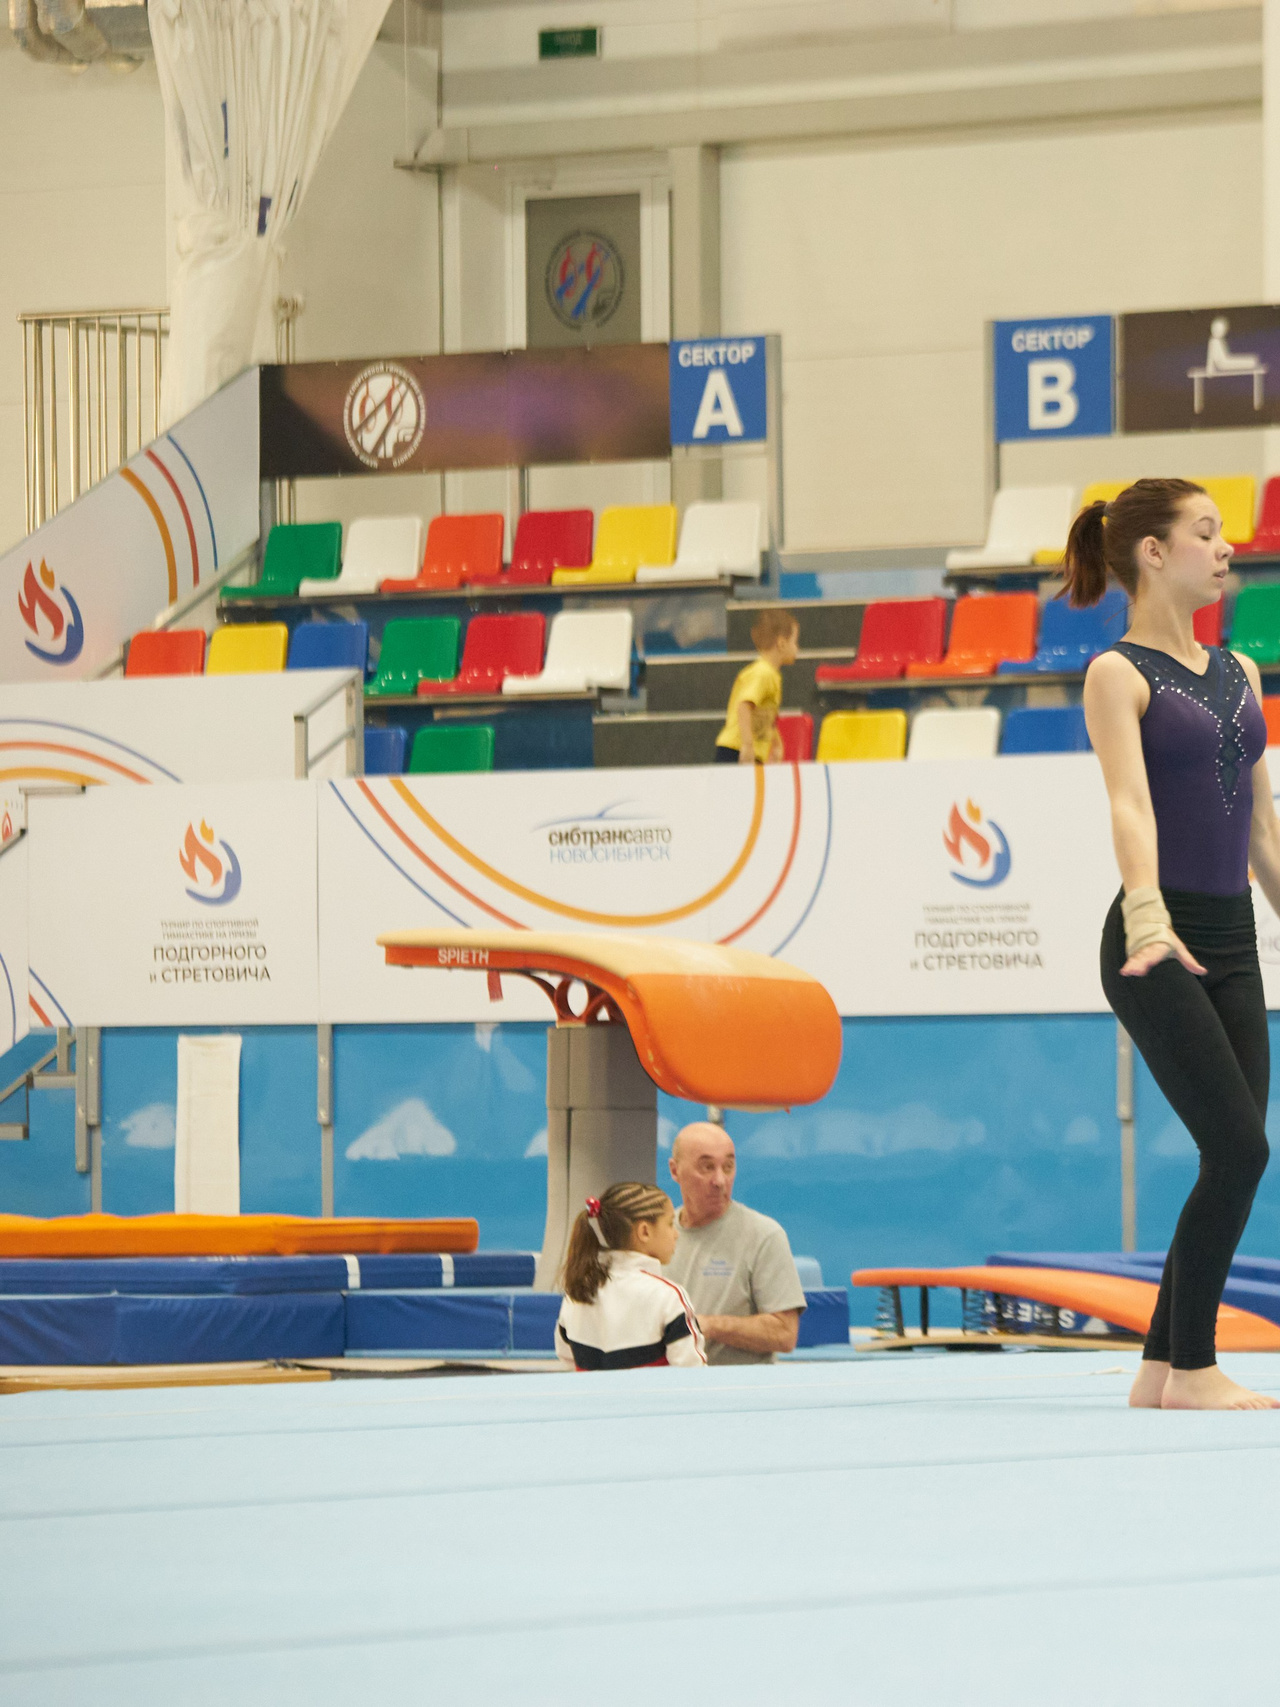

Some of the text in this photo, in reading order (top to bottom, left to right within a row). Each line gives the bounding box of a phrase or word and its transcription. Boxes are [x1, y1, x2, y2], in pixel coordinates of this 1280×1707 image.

[1011, 325, 1095, 353] СЕКТОР
[678, 342, 755, 367] СЕКТОР
[548, 826, 672, 848] сибтрансавто
[549, 846, 671, 863] НОВОСИБИРСК
[914, 930, 1039, 949] ПОДГОРНОГО
[153, 944, 267, 964] ПОДГОРНОГО
[438, 947, 489, 965] SPIETH
[923, 953, 1043, 971] СТРЕТОВИЧА
[161, 965, 271, 983] СТРЕТОВИЧА
